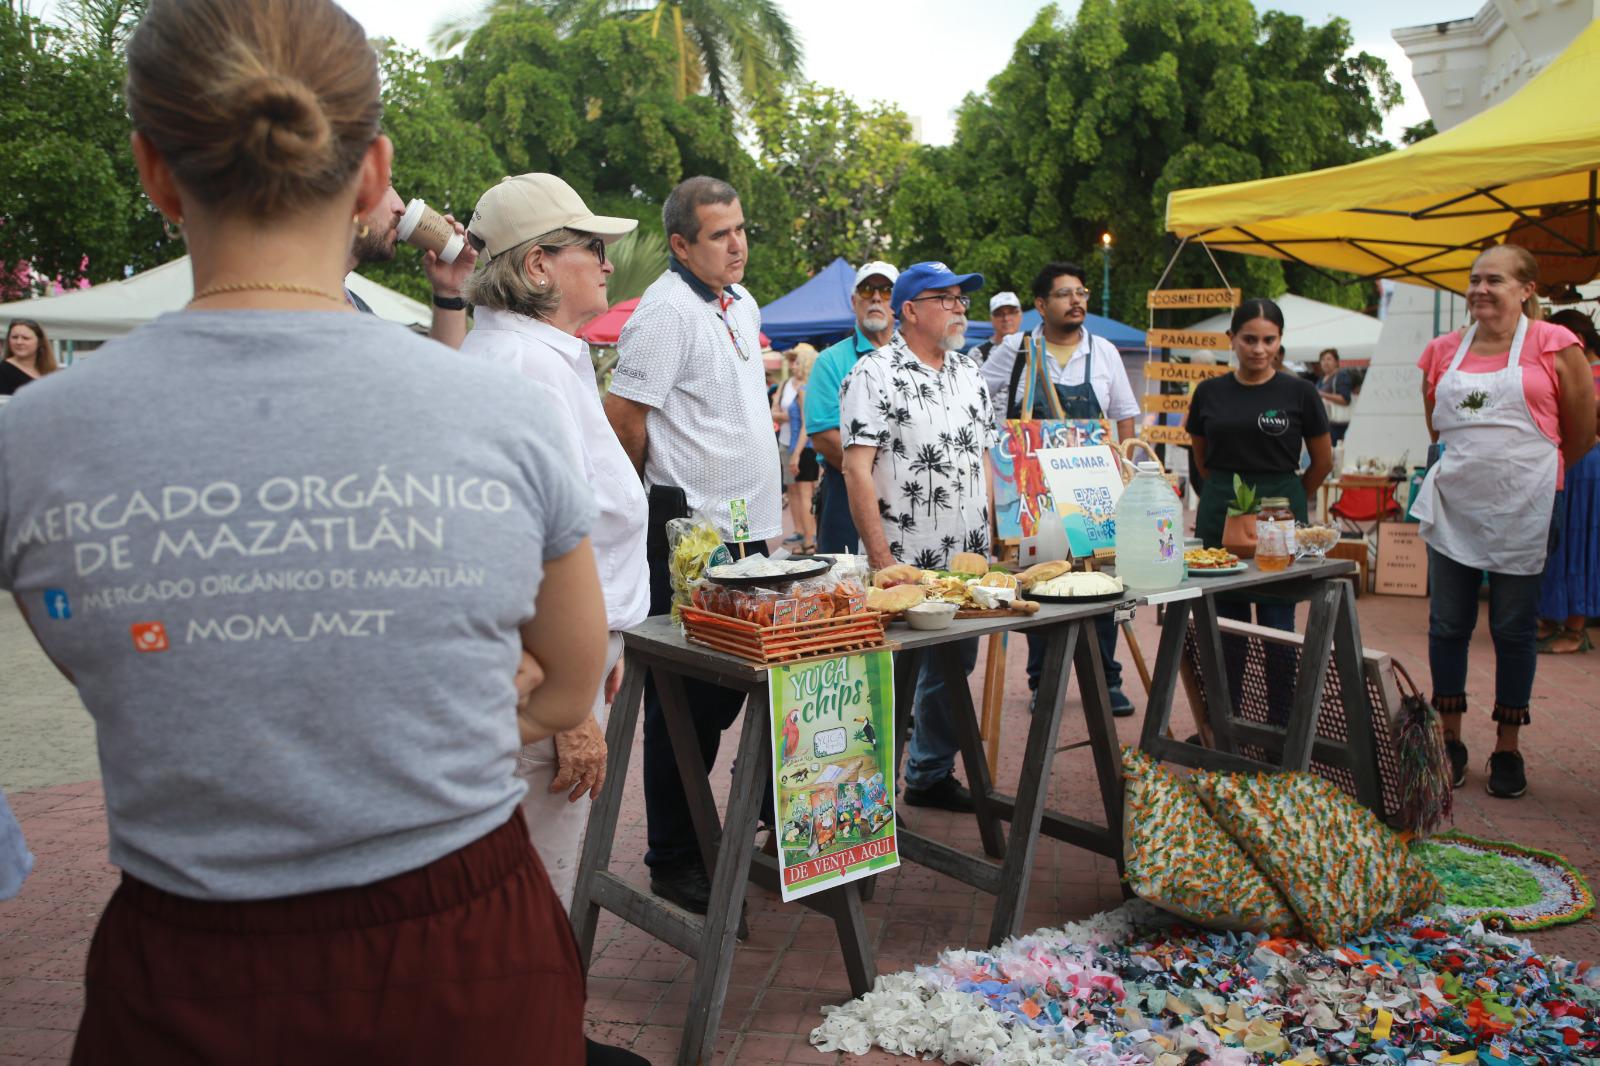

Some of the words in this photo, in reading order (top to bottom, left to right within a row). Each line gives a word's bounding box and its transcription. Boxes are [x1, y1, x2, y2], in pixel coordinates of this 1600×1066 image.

[1153, 292, 1232, 305] COSMETICOS
[1160, 367, 1215, 379] TOALLAS
[1162, 399, 1190, 411] COP
[11, 480, 242, 555] MERCADO
[257, 464, 513, 513] ORGÁNICO
[73, 534, 134, 578] DE
[151, 507, 445, 565] MAZATLÁN
[82, 578, 196, 613] MERCADO
[330, 568, 360, 589] DE
[185, 609, 395, 645] MOM_MZT
[790, 656, 848, 700] YUCA
[802, 679, 863, 723] chips
[790, 864, 809, 882] DE
[812, 850, 856, 874] VENTA
[860, 838, 891, 859] AQUI
